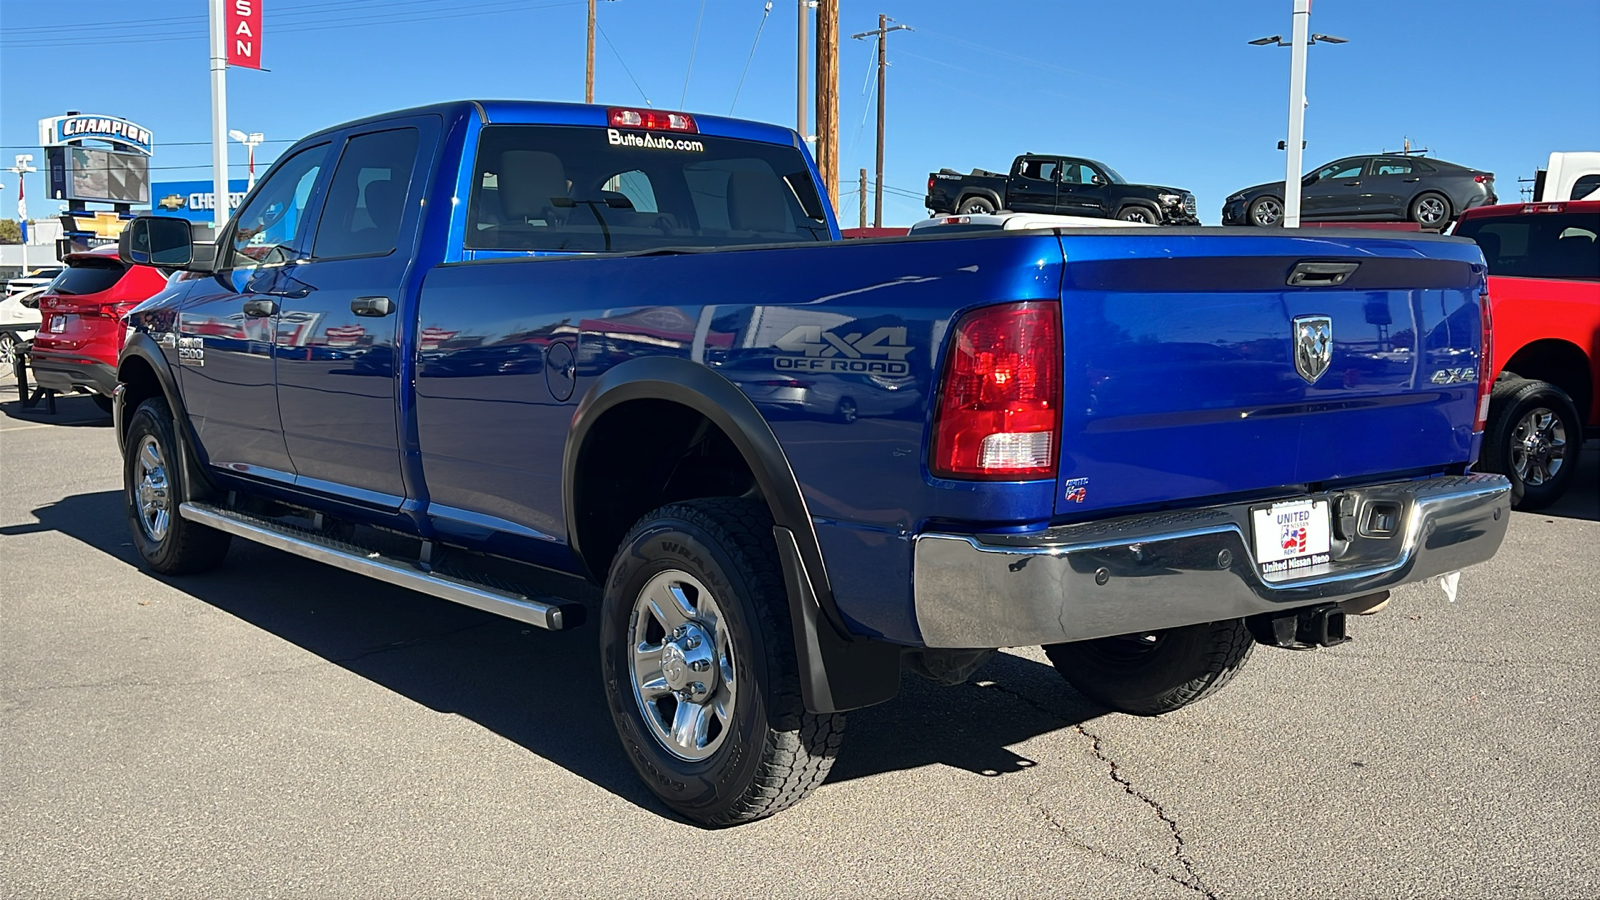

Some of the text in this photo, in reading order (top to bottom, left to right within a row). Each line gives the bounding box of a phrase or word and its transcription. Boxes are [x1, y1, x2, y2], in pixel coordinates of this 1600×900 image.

[62, 118, 151, 145] CHAMPION
[607, 128, 704, 152] ButteAuto.com
[178, 348, 204, 360] 2500
[776, 358, 907, 373] OFF ROAD
[1277, 510, 1310, 525] UNITED
[1290, 521, 1310, 529] NISSAN
[1262, 554, 1330, 573] United Nissan Reno
